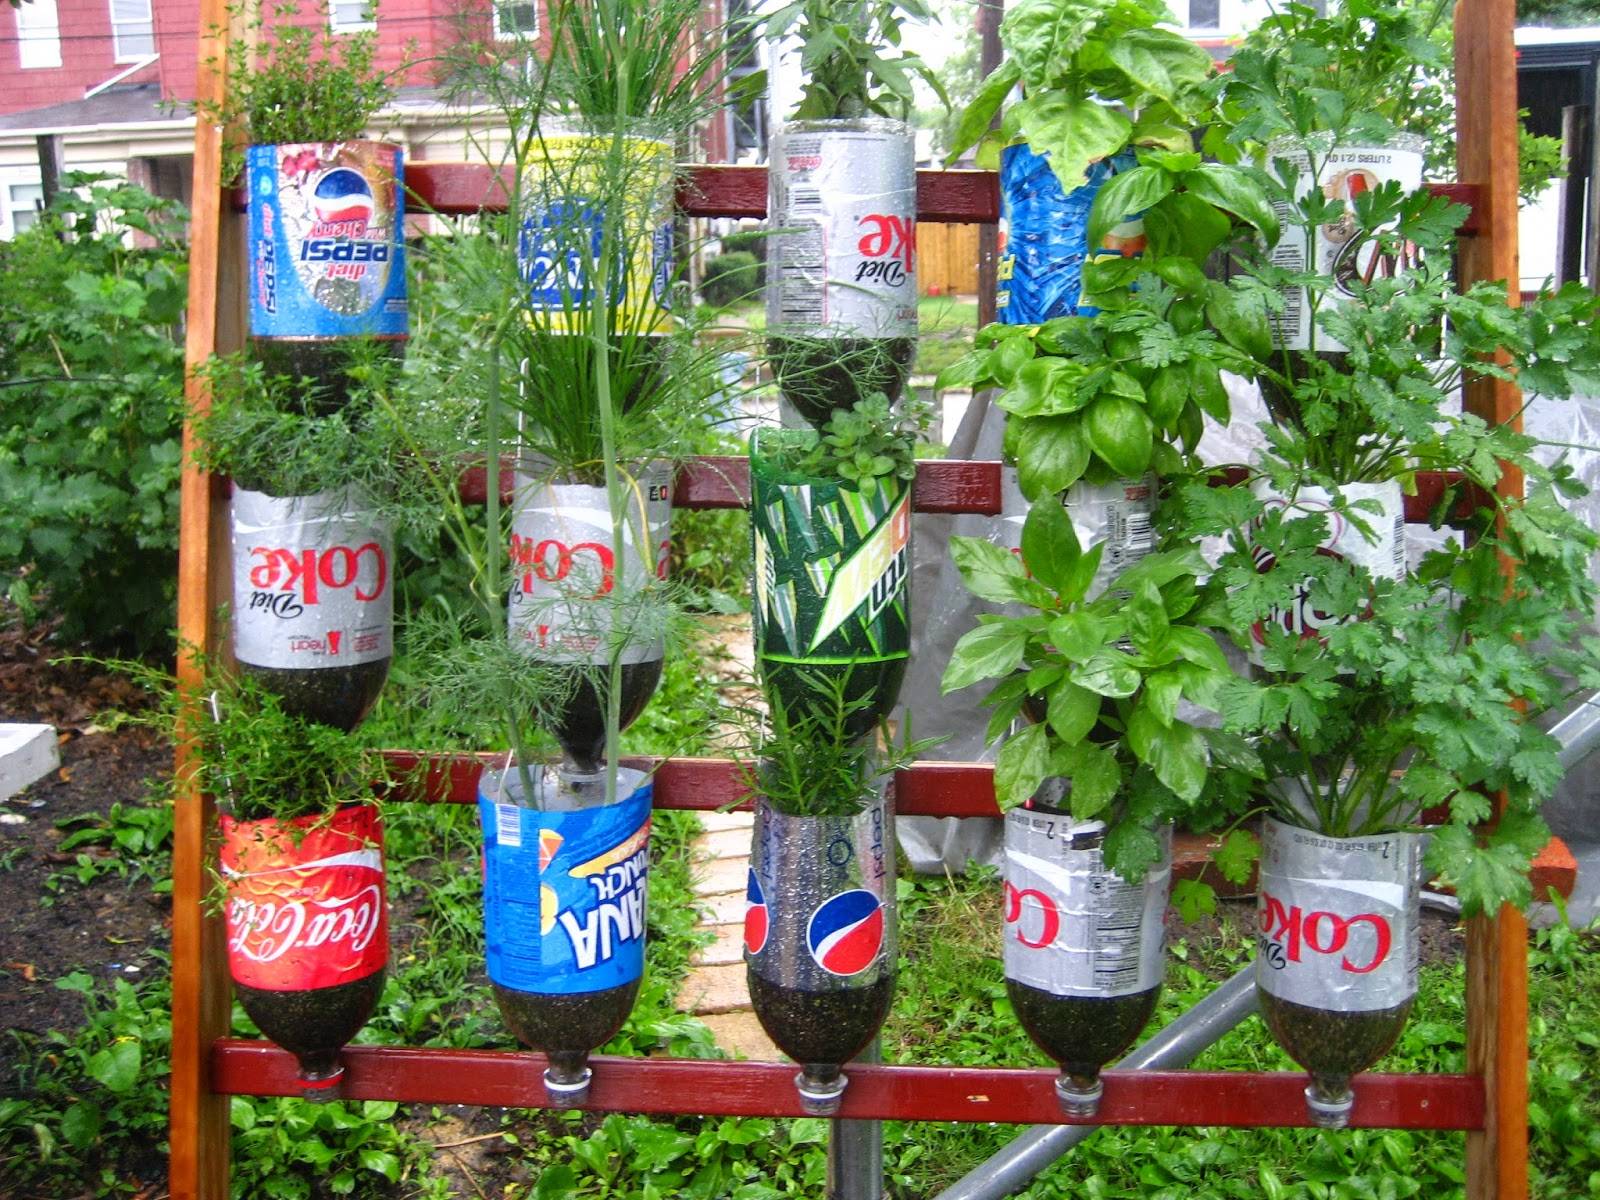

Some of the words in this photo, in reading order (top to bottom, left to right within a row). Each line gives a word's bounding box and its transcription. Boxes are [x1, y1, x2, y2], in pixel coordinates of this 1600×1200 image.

[300, 240, 388, 262] PEPSI
[326, 264, 367, 281] diet
[855, 260, 906, 288] Diet
[250, 543, 386, 606] Coke
[249, 591, 304, 619] Diet
[229, 884, 381, 963] Coca-Cola
